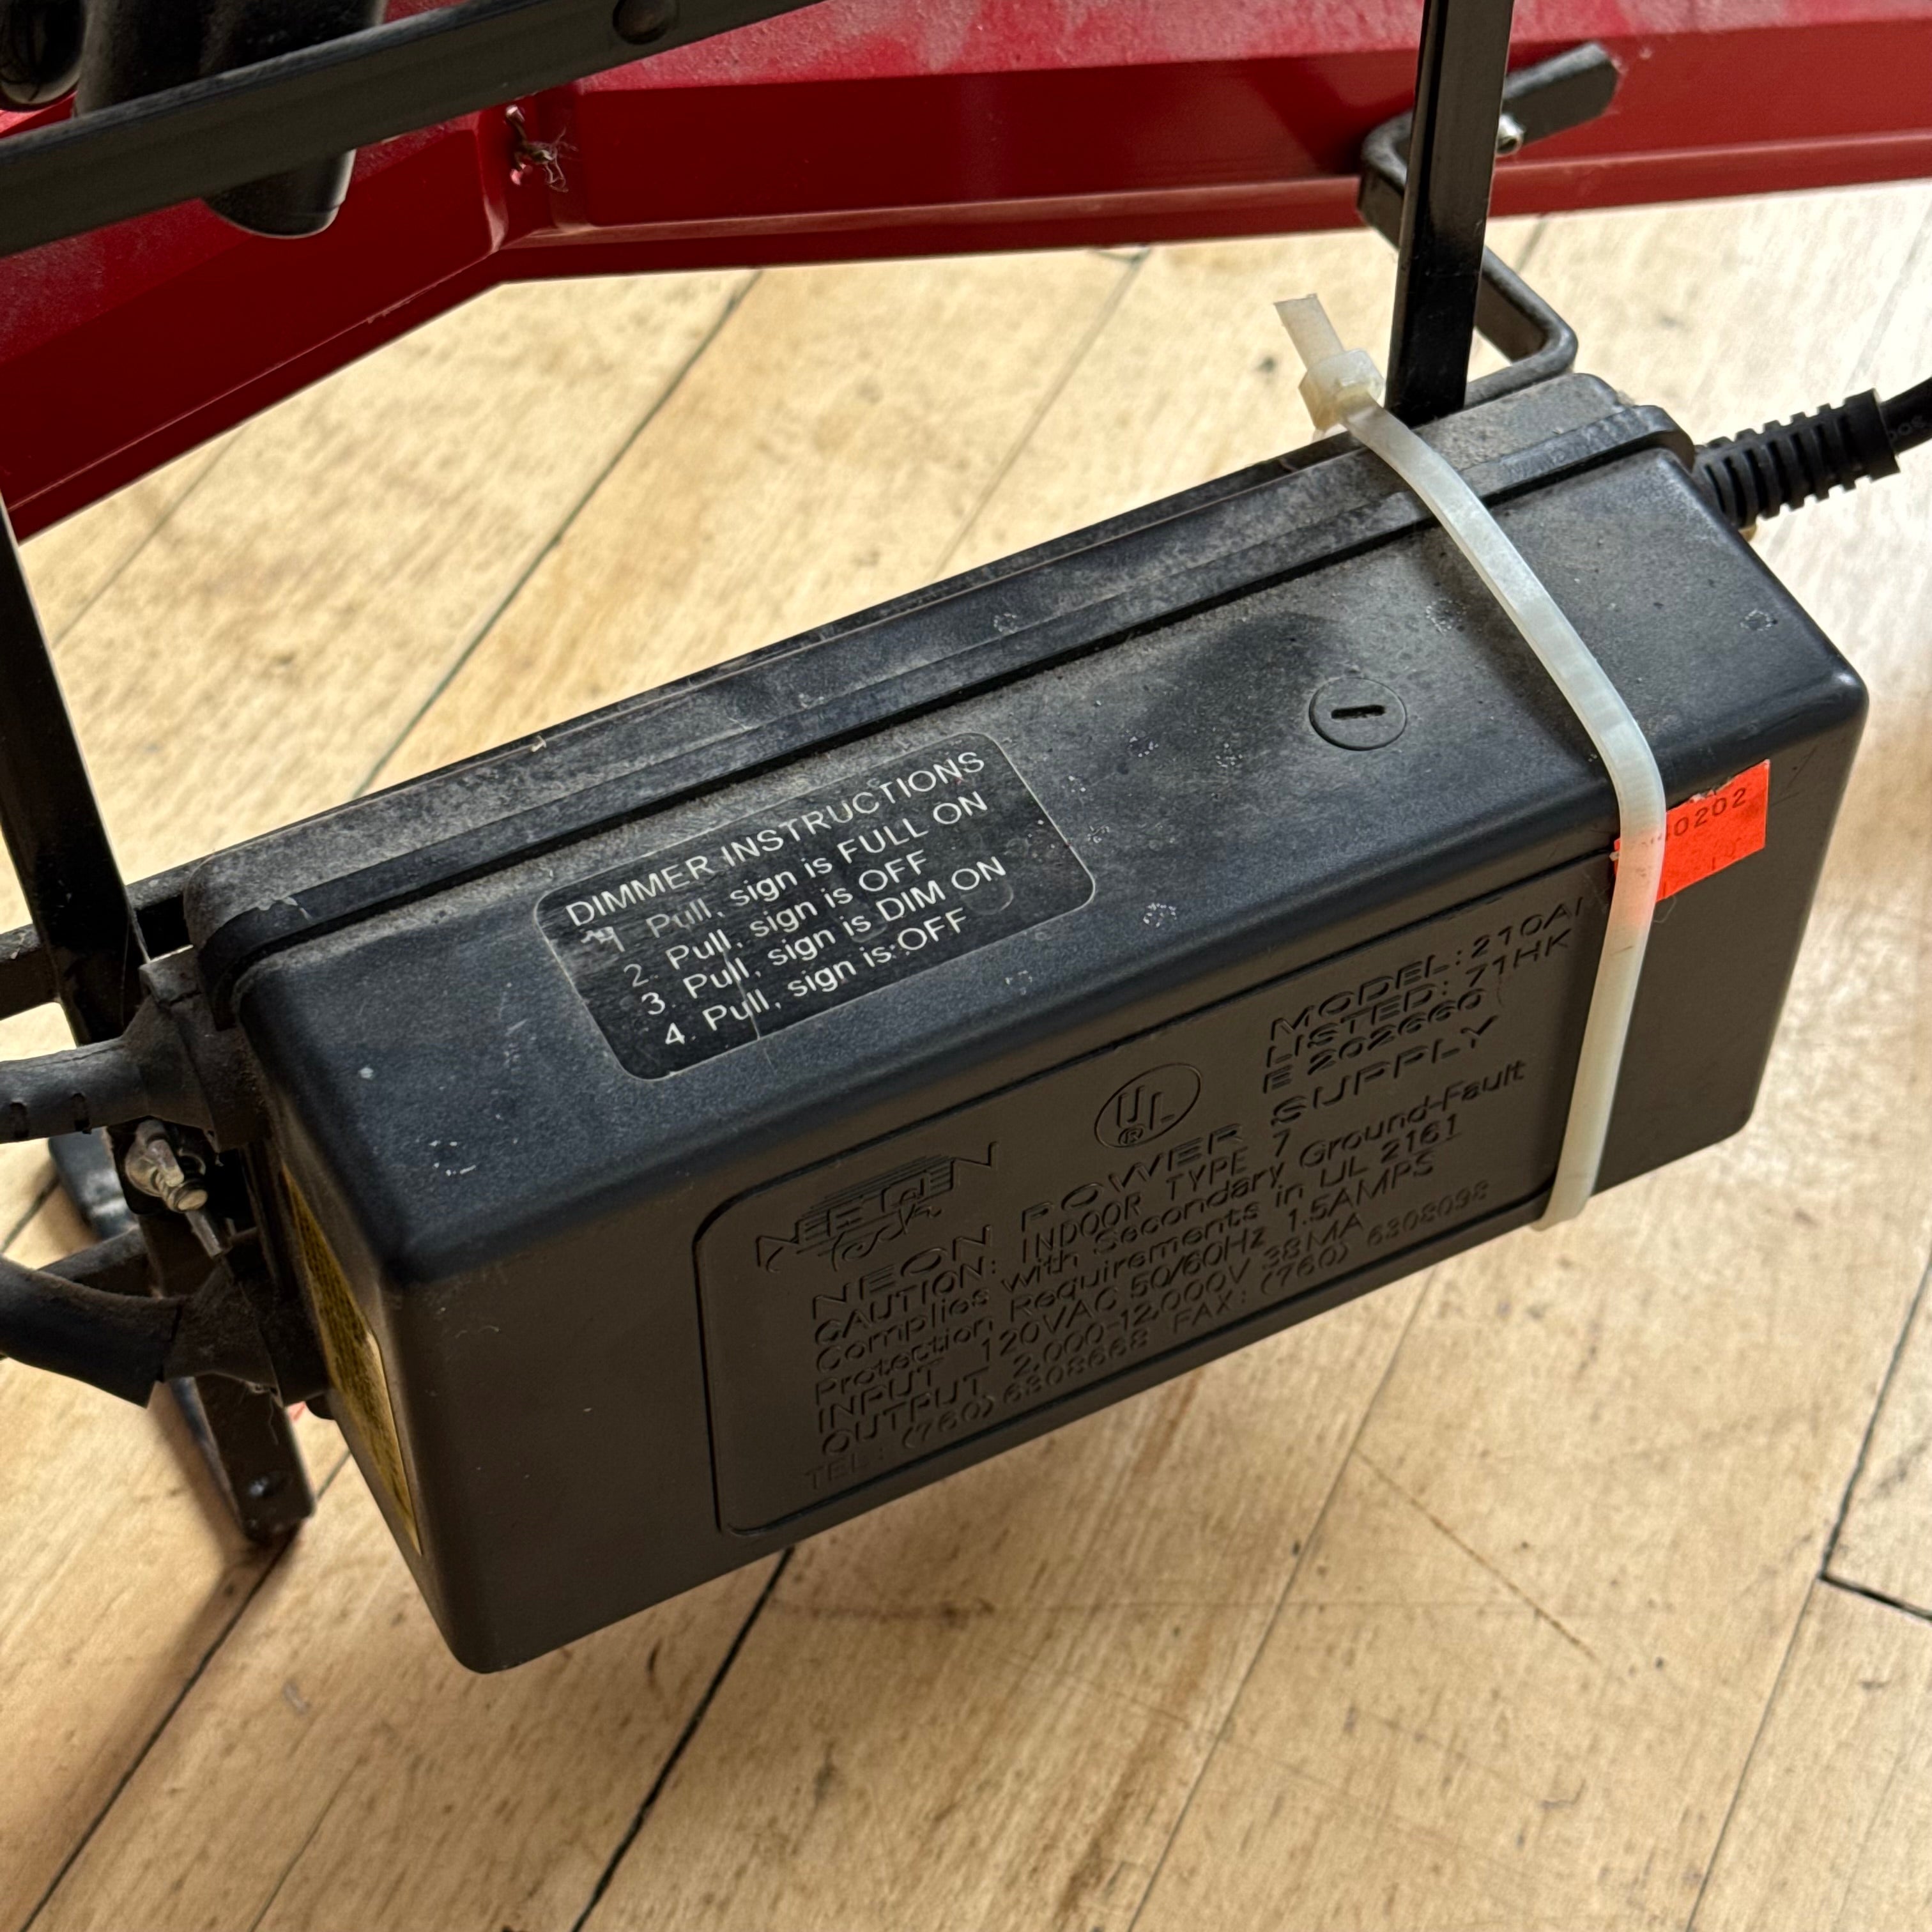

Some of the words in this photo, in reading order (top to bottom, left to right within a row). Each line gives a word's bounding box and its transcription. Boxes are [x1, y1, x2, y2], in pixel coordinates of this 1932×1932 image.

[565, 855, 716, 926] DIMMER
[721, 752, 985, 867] INSTRUCTIONS
[730, 870, 798, 907] sign
[800, 857, 832, 878] is
[838, 818, 928, 864] FULL
[933, 791, 988, 825] ON
[749, 901, 818, 937] sign
[820, 887, 853, 908] is
[859, 849, 926, 892] OFF
[768, 929, 836, 965] sign
[839, 916, 871, 936] is
[876, 880, 946, 921] DIM
[951, 856, 1006, 890] ON
[788, 960, 856, 997] sign
[859, 946, 891, 967] is
[898, 907, 967, 951] OFF
[1266, 981, 1448, 1068] LISTED:
[1466, 928, 1572, 987] 71HK
[812, 1225, 993, 1321] NEON
[1021, 1124, 1243, 1233] POWER
[1271, 1015, 1498, 1127] SUPPLY
[1117, 1085, 1176, 1131] UL
[815, 1256, 996, 1346] CAUTION:
[1023, 1192, 1142, 1263] INDOOR
[1166, 1147, 1248, 1201] TYPE
[1273, 1128, 1291, 1158] 7
[815, 1316, 993, 1406] Protection
[1011, 1202, 1260, 1322] Requirements
[1275, 1183, 1303, 1208] in
[1320, 1156, 1368, 1188] UL
[1381, 1113, 1462, 1164] 2161
[816, 1288, 990, 1372] Complies
[1001, 1250, 1078, 1293] with
[1094, 1162, 1286, 1255] Secondary
[1299, 1059, 1527, 1169] Ground-Fault
[818, 1357, 945, 1434] INPUT
[981, 1286, 1119, 1362] 120VAC
[1130, 1227, 1266, 1298] 50/60Hz
[1288, 1151, 1434, 1232] 1.5AMPS
[822, 1366, 990, 1455] OUTPUT
[1262, 1212, 1363, 1270] 38MA
[901, 1395, 997, 1449] (760)
[1261, 1246, 1349, 1296] (760)
